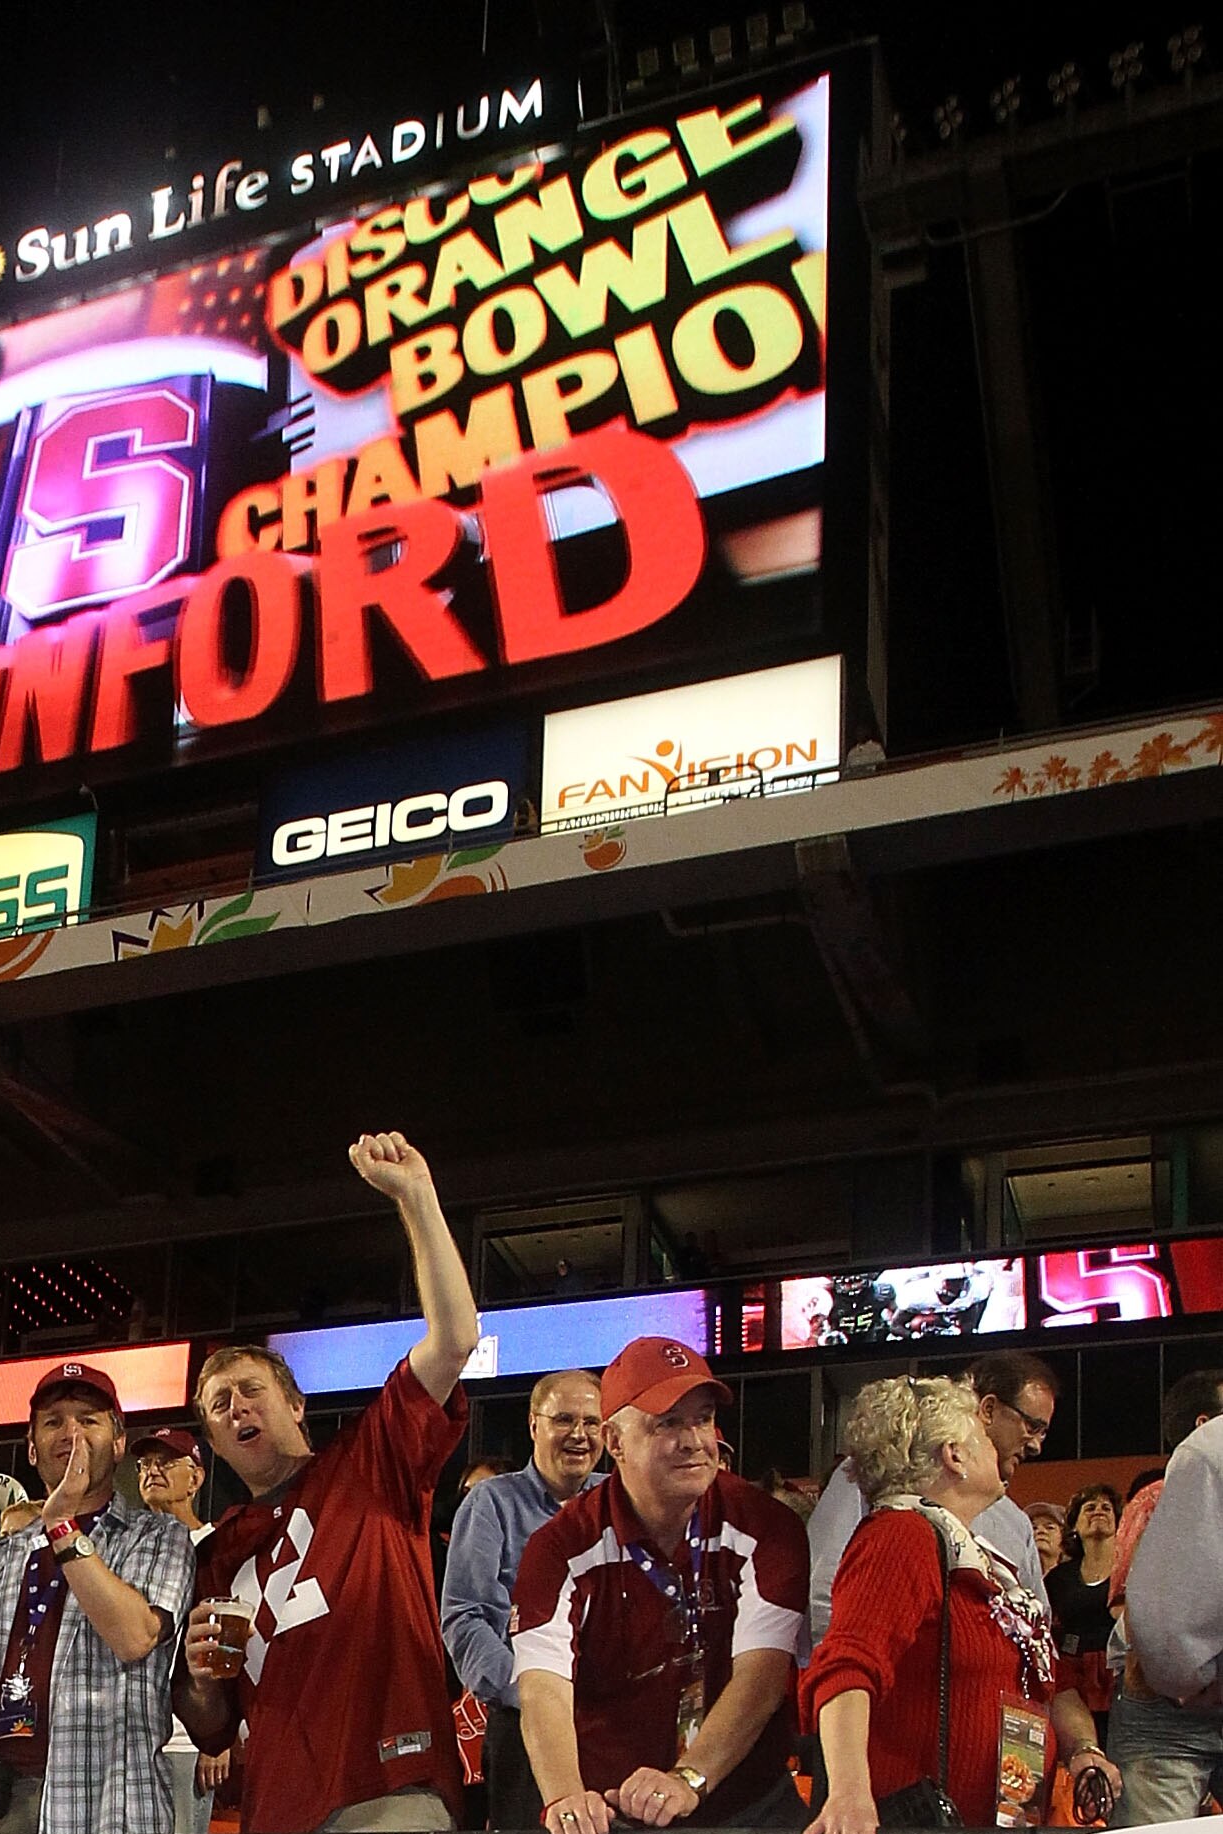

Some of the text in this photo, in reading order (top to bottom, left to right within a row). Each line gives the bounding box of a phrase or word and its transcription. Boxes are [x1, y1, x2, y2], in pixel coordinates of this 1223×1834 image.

[14, 78, 544, 284] Sun Life STADIUM
[301, 96, 797, 373] ORANGE
[389, 190, 795, 416] BOWL
[4, 387, 198, 619] S
[271, 780, 510, 867] GEICO
[557, 738, 818, 809] FANVISION
